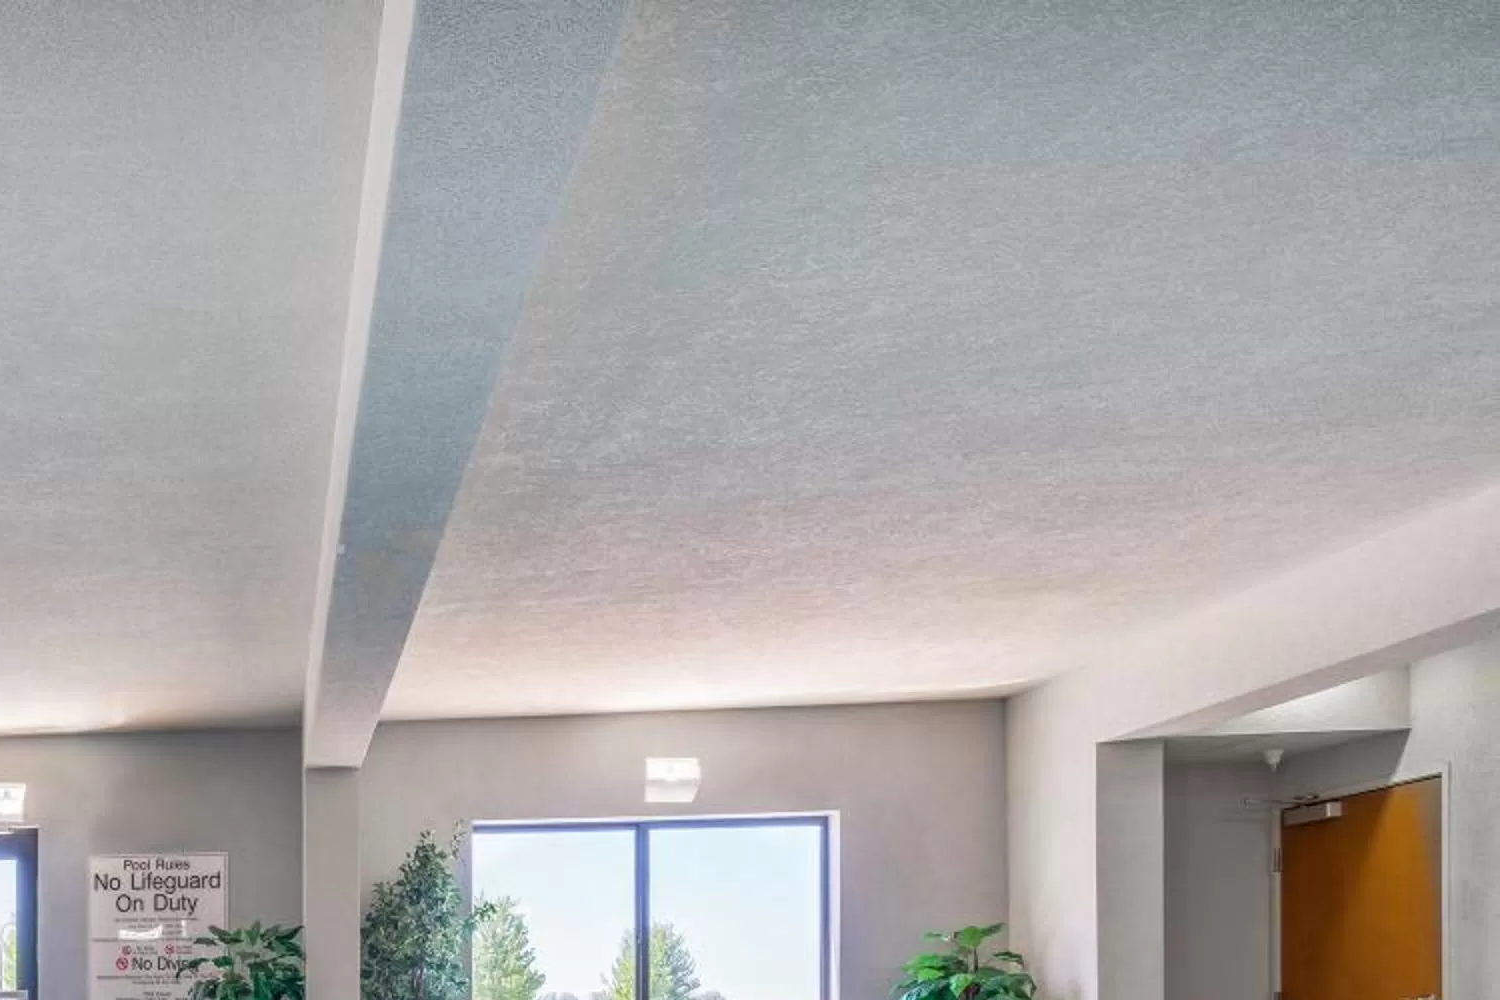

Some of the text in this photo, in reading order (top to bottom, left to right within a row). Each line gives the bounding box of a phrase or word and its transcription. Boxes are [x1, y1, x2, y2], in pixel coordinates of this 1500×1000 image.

[123, 859, 191, 871] Pool Rules
[93, 871, 221, 895] No Lifeguard
[116, 893, 199, 917] On Duty
[131, 956, 153, 971] No
